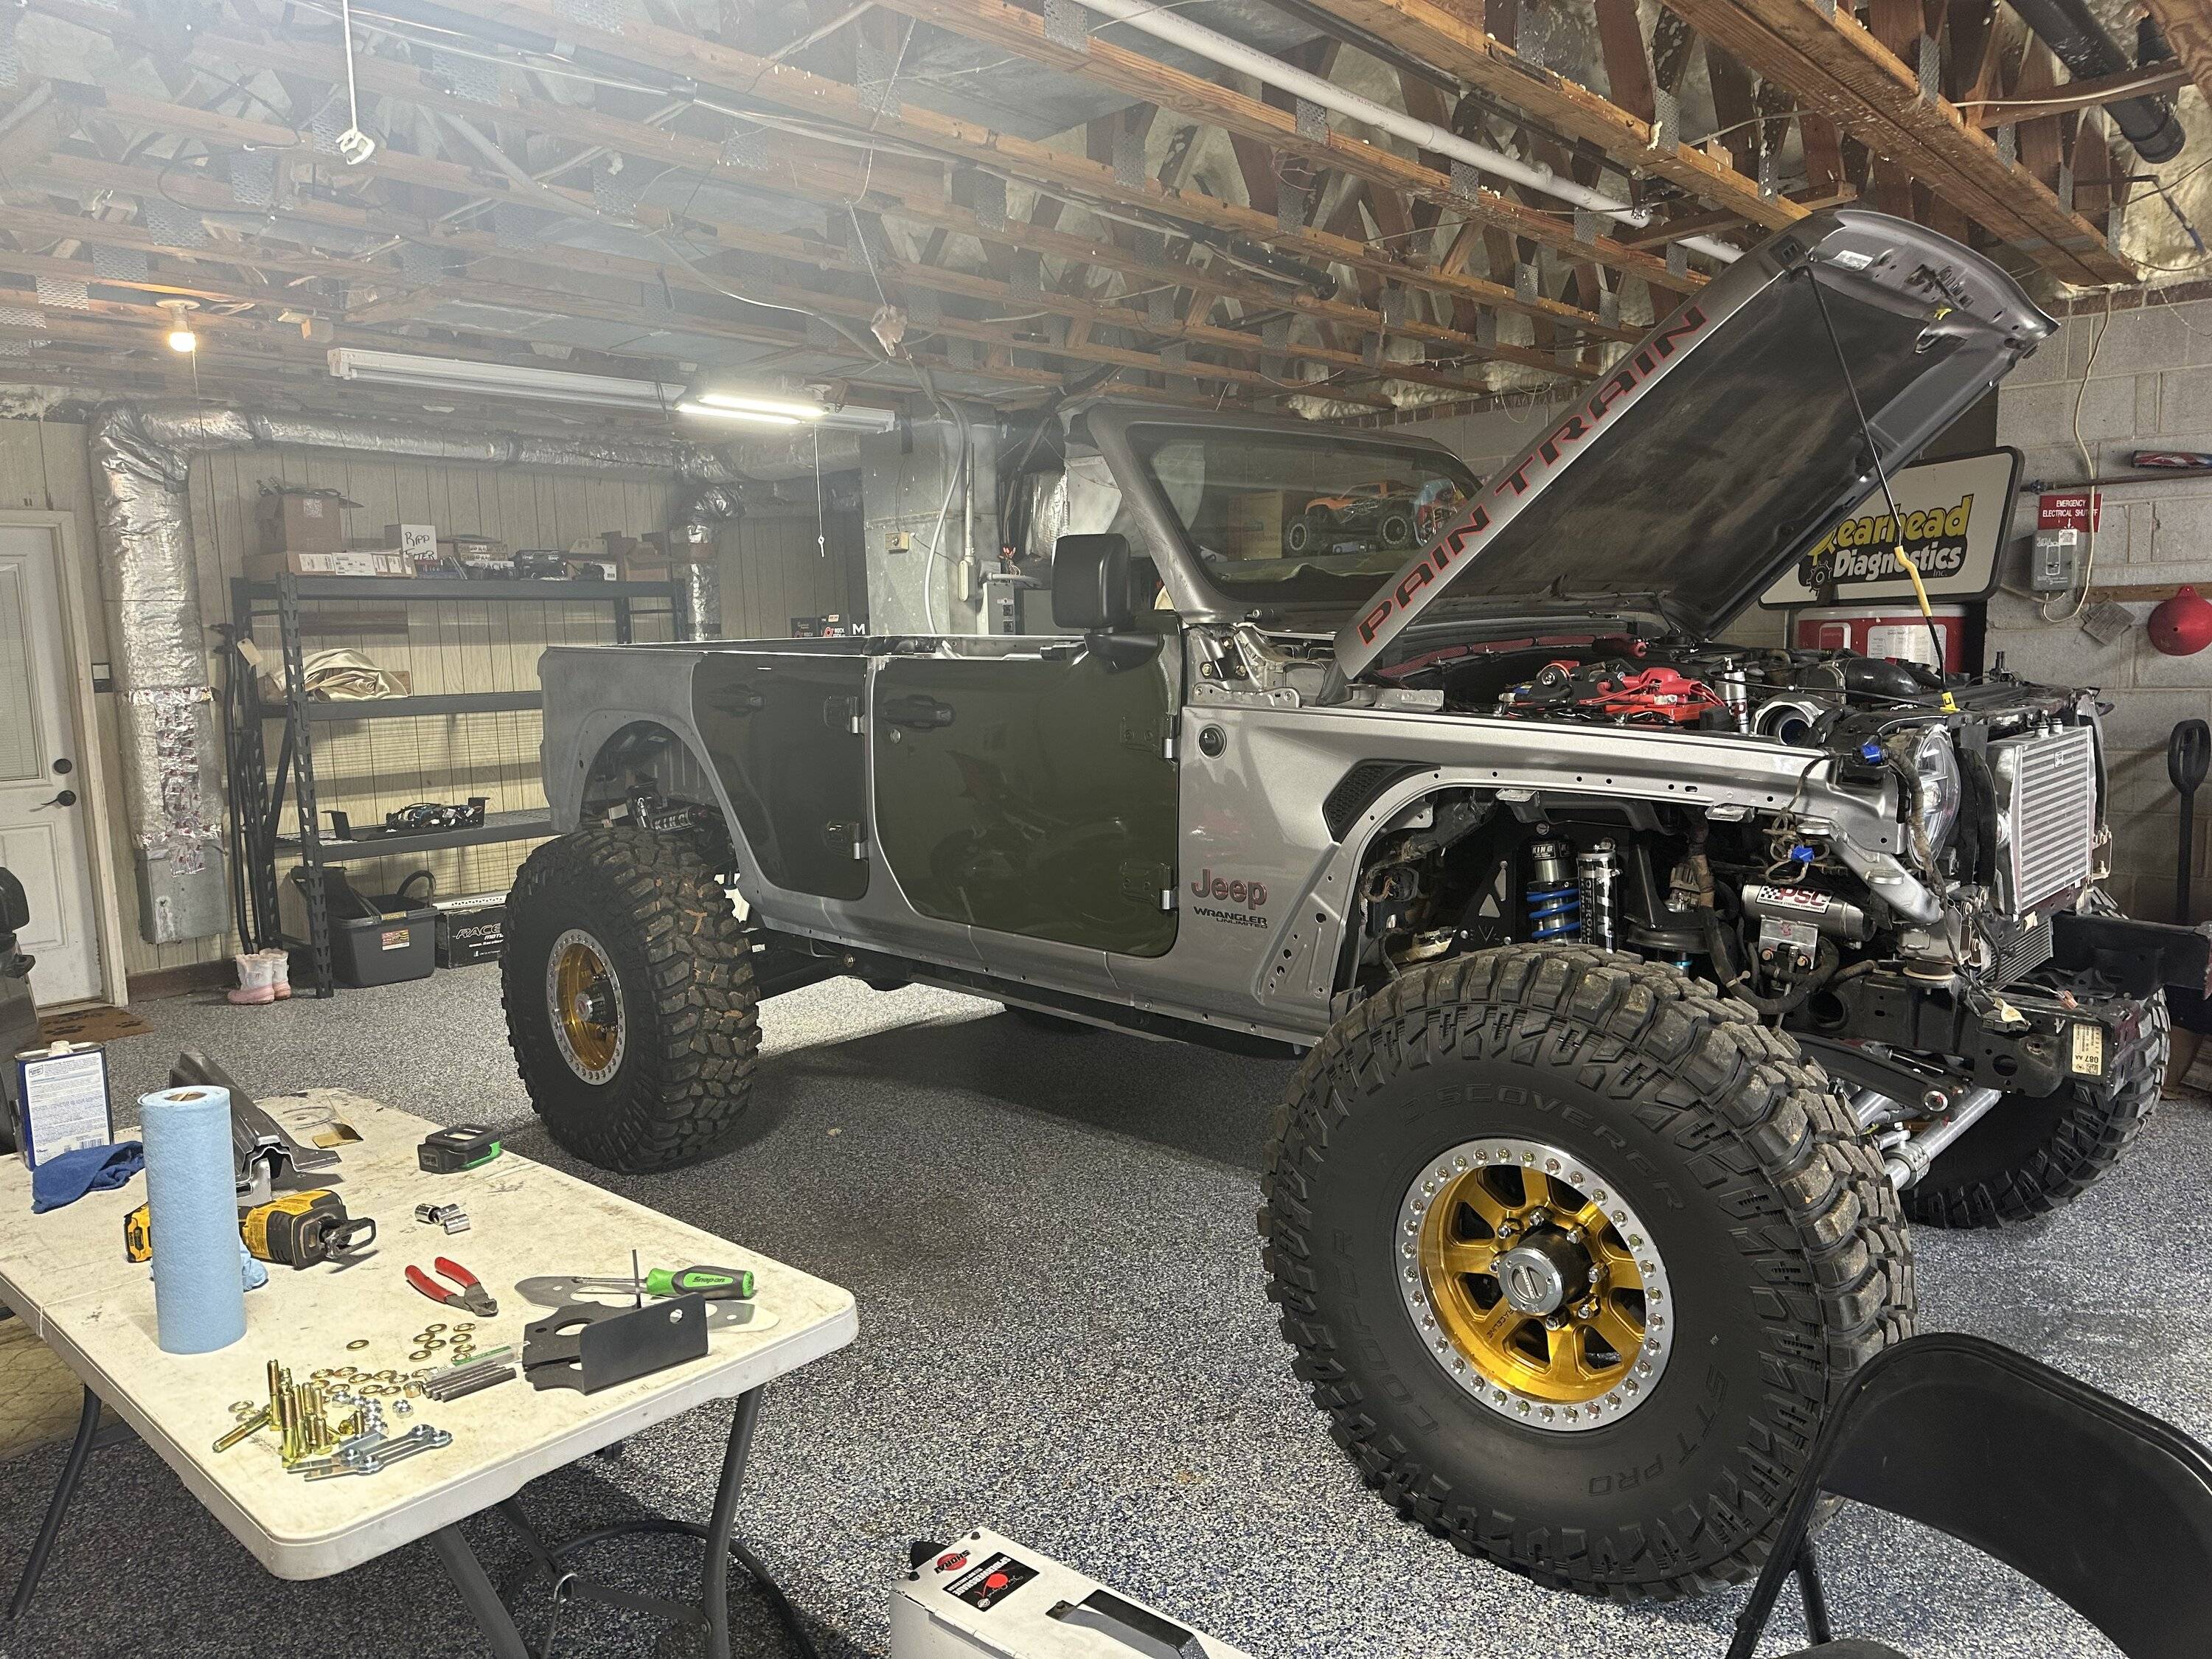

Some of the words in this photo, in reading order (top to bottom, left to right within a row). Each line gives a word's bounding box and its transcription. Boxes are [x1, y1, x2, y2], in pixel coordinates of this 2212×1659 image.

[1355, 503, 1491, 646] PAIN
[1493, 304, 1708, 497] TRAIN
[2042, 509, 2072, 518] ELECTRICAL
[1833, 540, 1962, 581] Diagnostics
[654, 813, 686, 830] KING
[1191, 869, 1267, 910] Jeep
[1775, 885, 1832, 906] PSC
[1193, 906, 1267, 925] WRANGLER
[1217, 917, 1267, 929] UNLIMITED
[2085, 1055, 2098, 1063] 087
[933, 1549, 971, 1574] SHORAI
